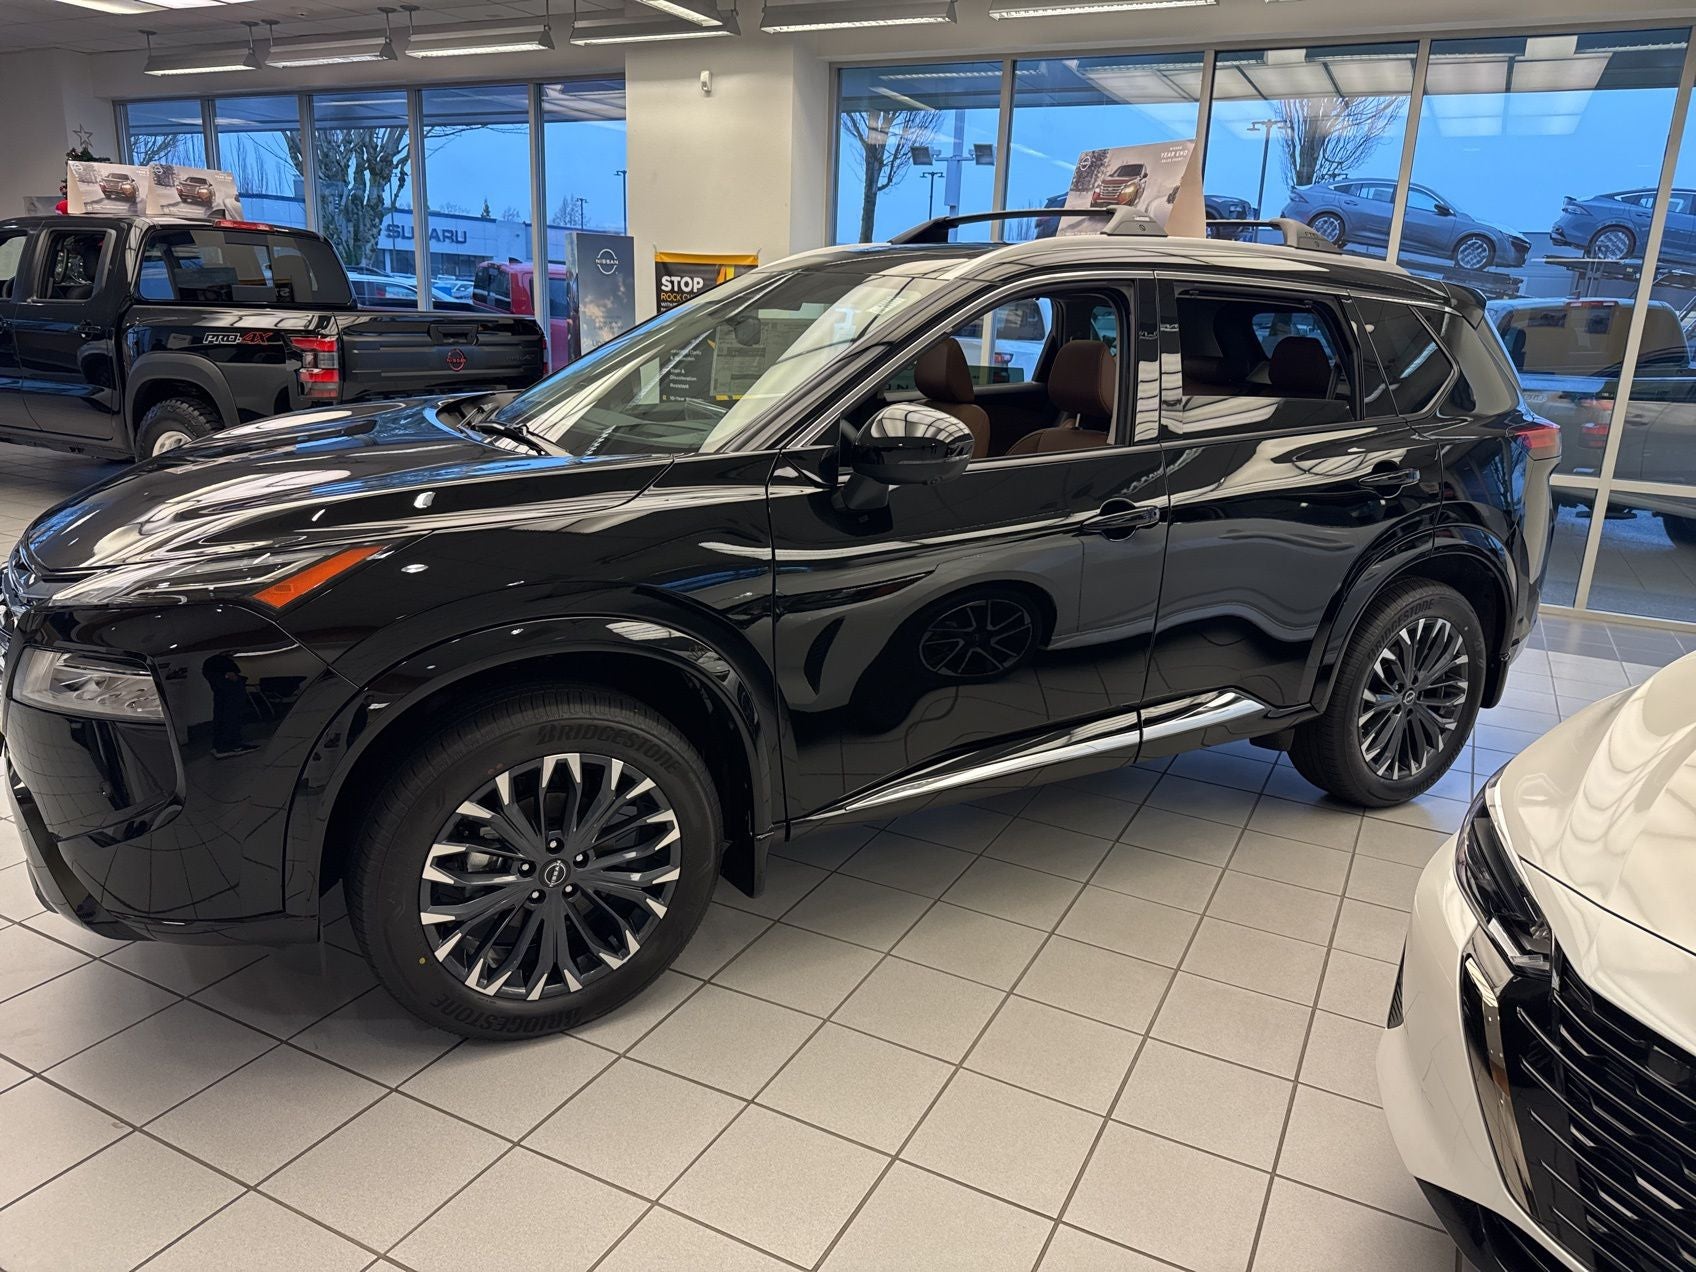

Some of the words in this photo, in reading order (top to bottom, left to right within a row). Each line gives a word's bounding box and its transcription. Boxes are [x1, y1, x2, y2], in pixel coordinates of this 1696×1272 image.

[385, 223, 467, 244] SUARU
[661, 275, 704, 292] STOP
[661, 292, 681, 301] ROCK
[536, 724, 681, 773] BRIDGESTONE
[430, 993, 583, 1033] BRIDGESTONE
